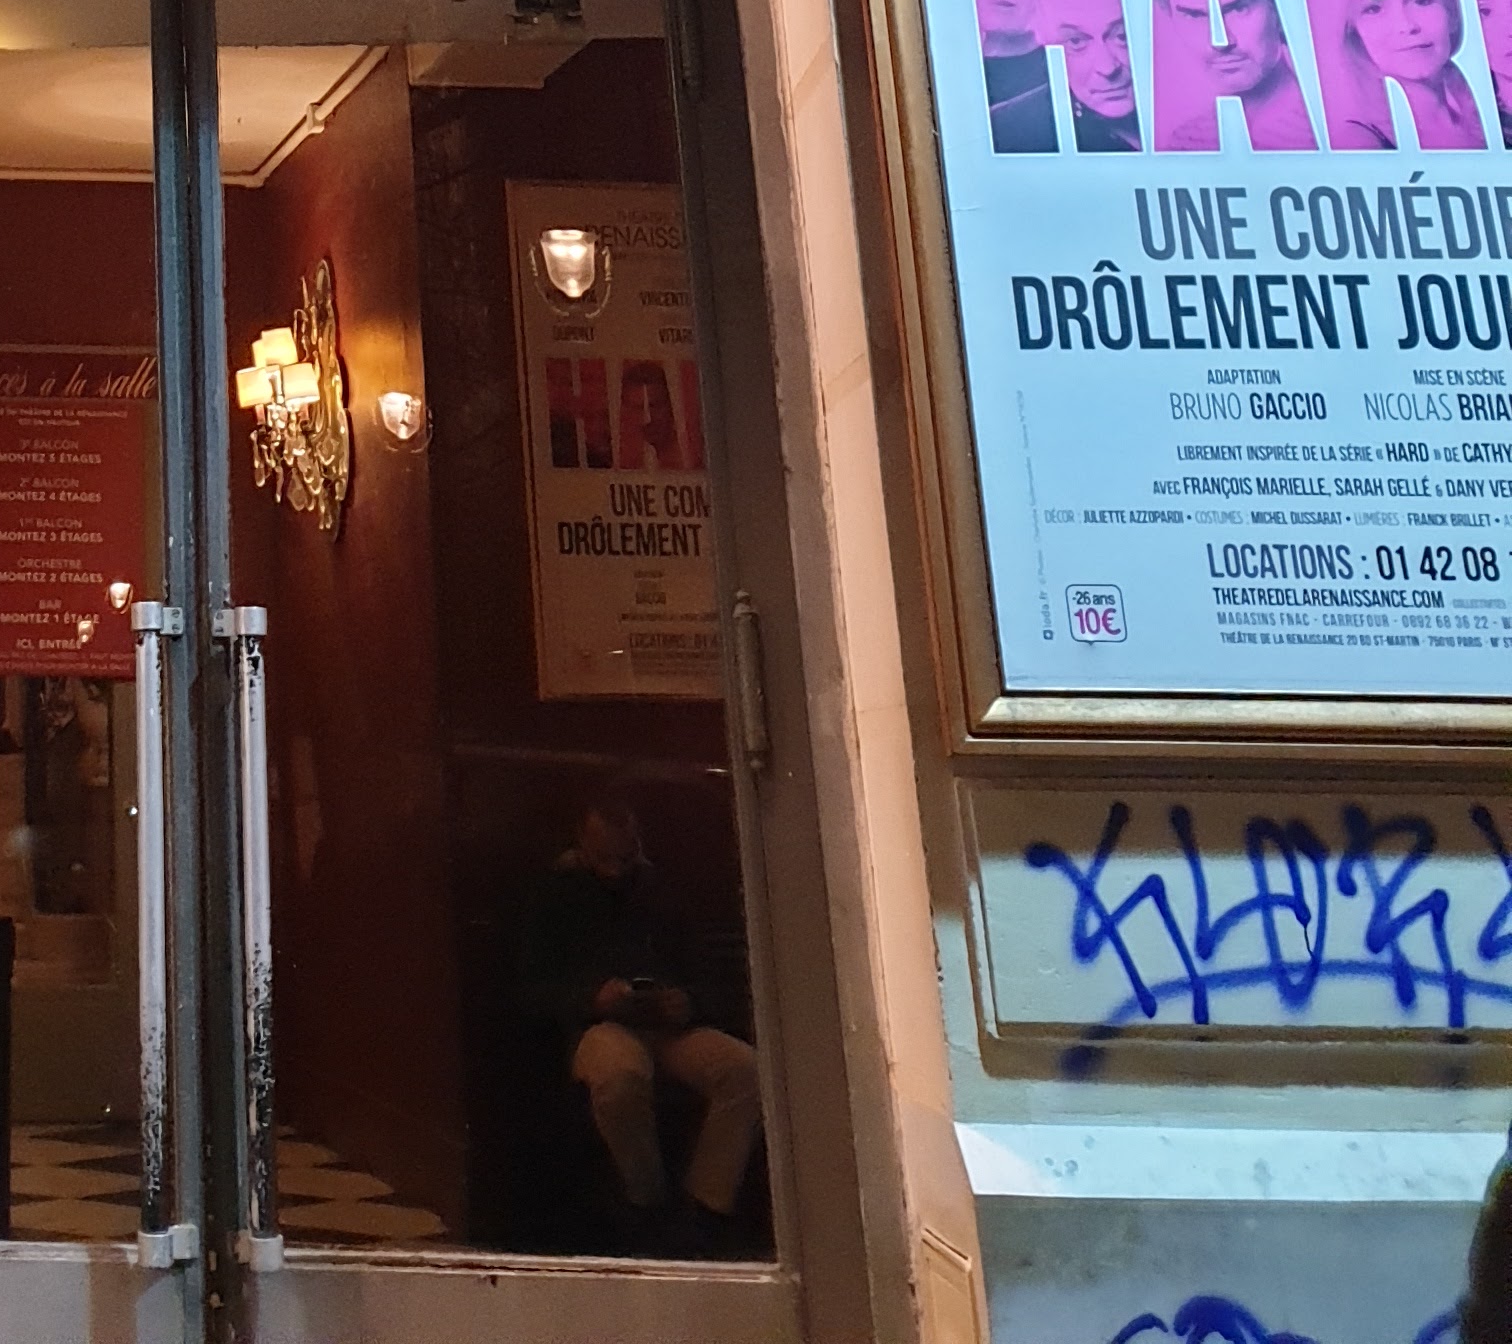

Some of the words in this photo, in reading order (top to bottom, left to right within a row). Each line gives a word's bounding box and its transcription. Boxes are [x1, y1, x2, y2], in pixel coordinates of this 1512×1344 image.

[1132, 185, 1257, 262] UNE
[1010, 259, 1372, 352] DRÔLEMENT
[1397, 273, 1512, 352] JOU
[63, 362, 88, 397] la
[97, 356, 158, 399] salle
[1207, 368, 1282, 386] ADAPTATION
[1412, 369, 1445, 386] MISE
[1445, 369, 1465, 386] EN
[1466, 366, 1507, 387] SCÈNE
[1169, 391, 1243, 421] BRUNO
[1248, 391, 1328, 421] GACCIO
[1363, 392, 1455, 422] NICOLAS
[1456, 392, 1512, 422] BRIA
[1176, 444, 1243, 462] LIBREMENT
[1246, 442, 1301, 462] INSPIRÉE
[1302, 445, 1320, 462] DE
[1320, 445, 1338, 462] LA
[1339, 442, 1374, 463] SÉRIE
[1384, 442, 1431, 464] HARD
[1443, 446, 1461, 463] DE
[609, 482, 658, 518] UNE
[1152, 480, 1182, 496] AVEC
[1182, 476, 1254, 500] FRANÇOIS
[1255, 477, 1333, 499] MARIELLE,
[1334, 477, 1386, 497] SARAH
[1386, 474, 1432, 499] GELLÉ
[1444, 478, 1487, 499] DANY
[557, 513, 703, 558] DRÔLEMENT
[1206, 542, 1355, 581] LOCATIONS
[1374, 545, 1411, 581] 01
[1419, 545, 1458, 582] 42
[1461, 545, 1501, 582] 08
[1091, 592, 1117, 606] ans
[1211, 586, 1446, 609] THEATREDELARENAISSANCE.COM
[1073, 606, 1122, 636] 10€
